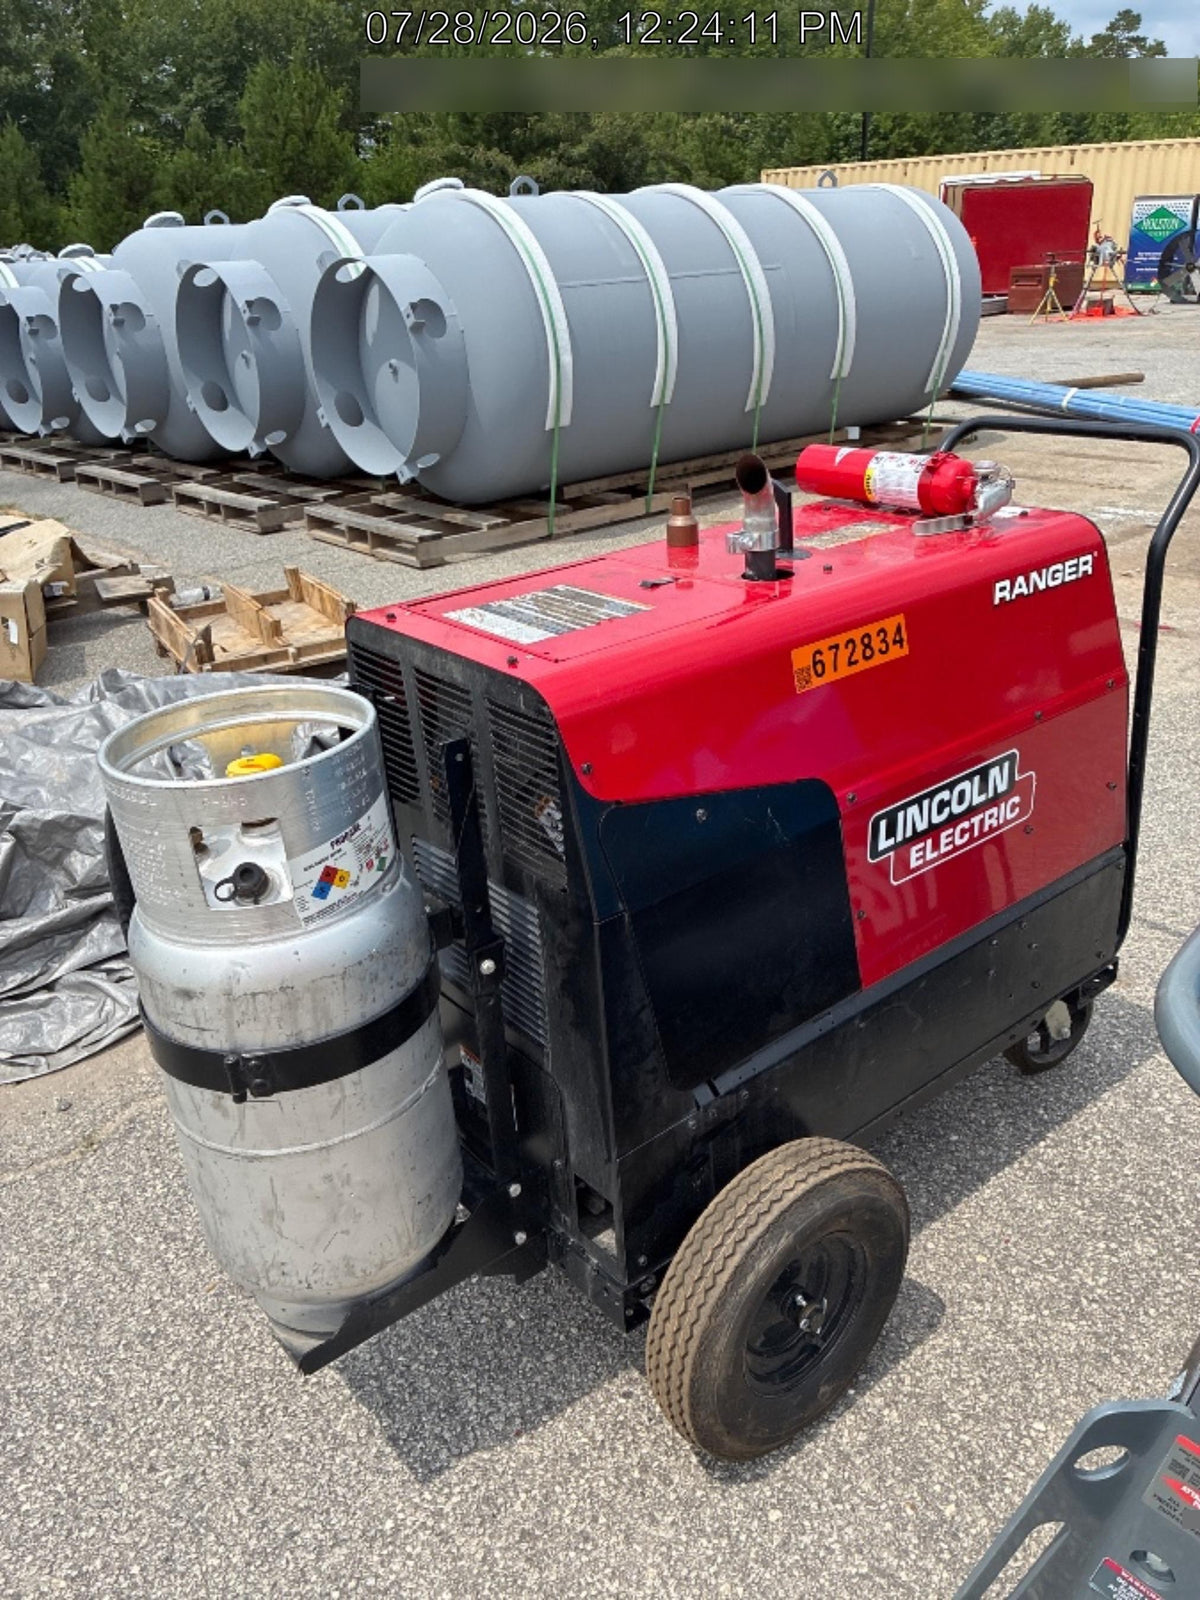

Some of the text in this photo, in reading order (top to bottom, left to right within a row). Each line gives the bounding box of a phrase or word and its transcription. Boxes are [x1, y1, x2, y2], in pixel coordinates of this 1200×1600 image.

[993, 554, 1093, 605] RANGER
[811, 622, 904, 678] 672834
[877, 760, 1011, 852] LINCOLN
[909, 795, 1022, 870] ELECTRIC
